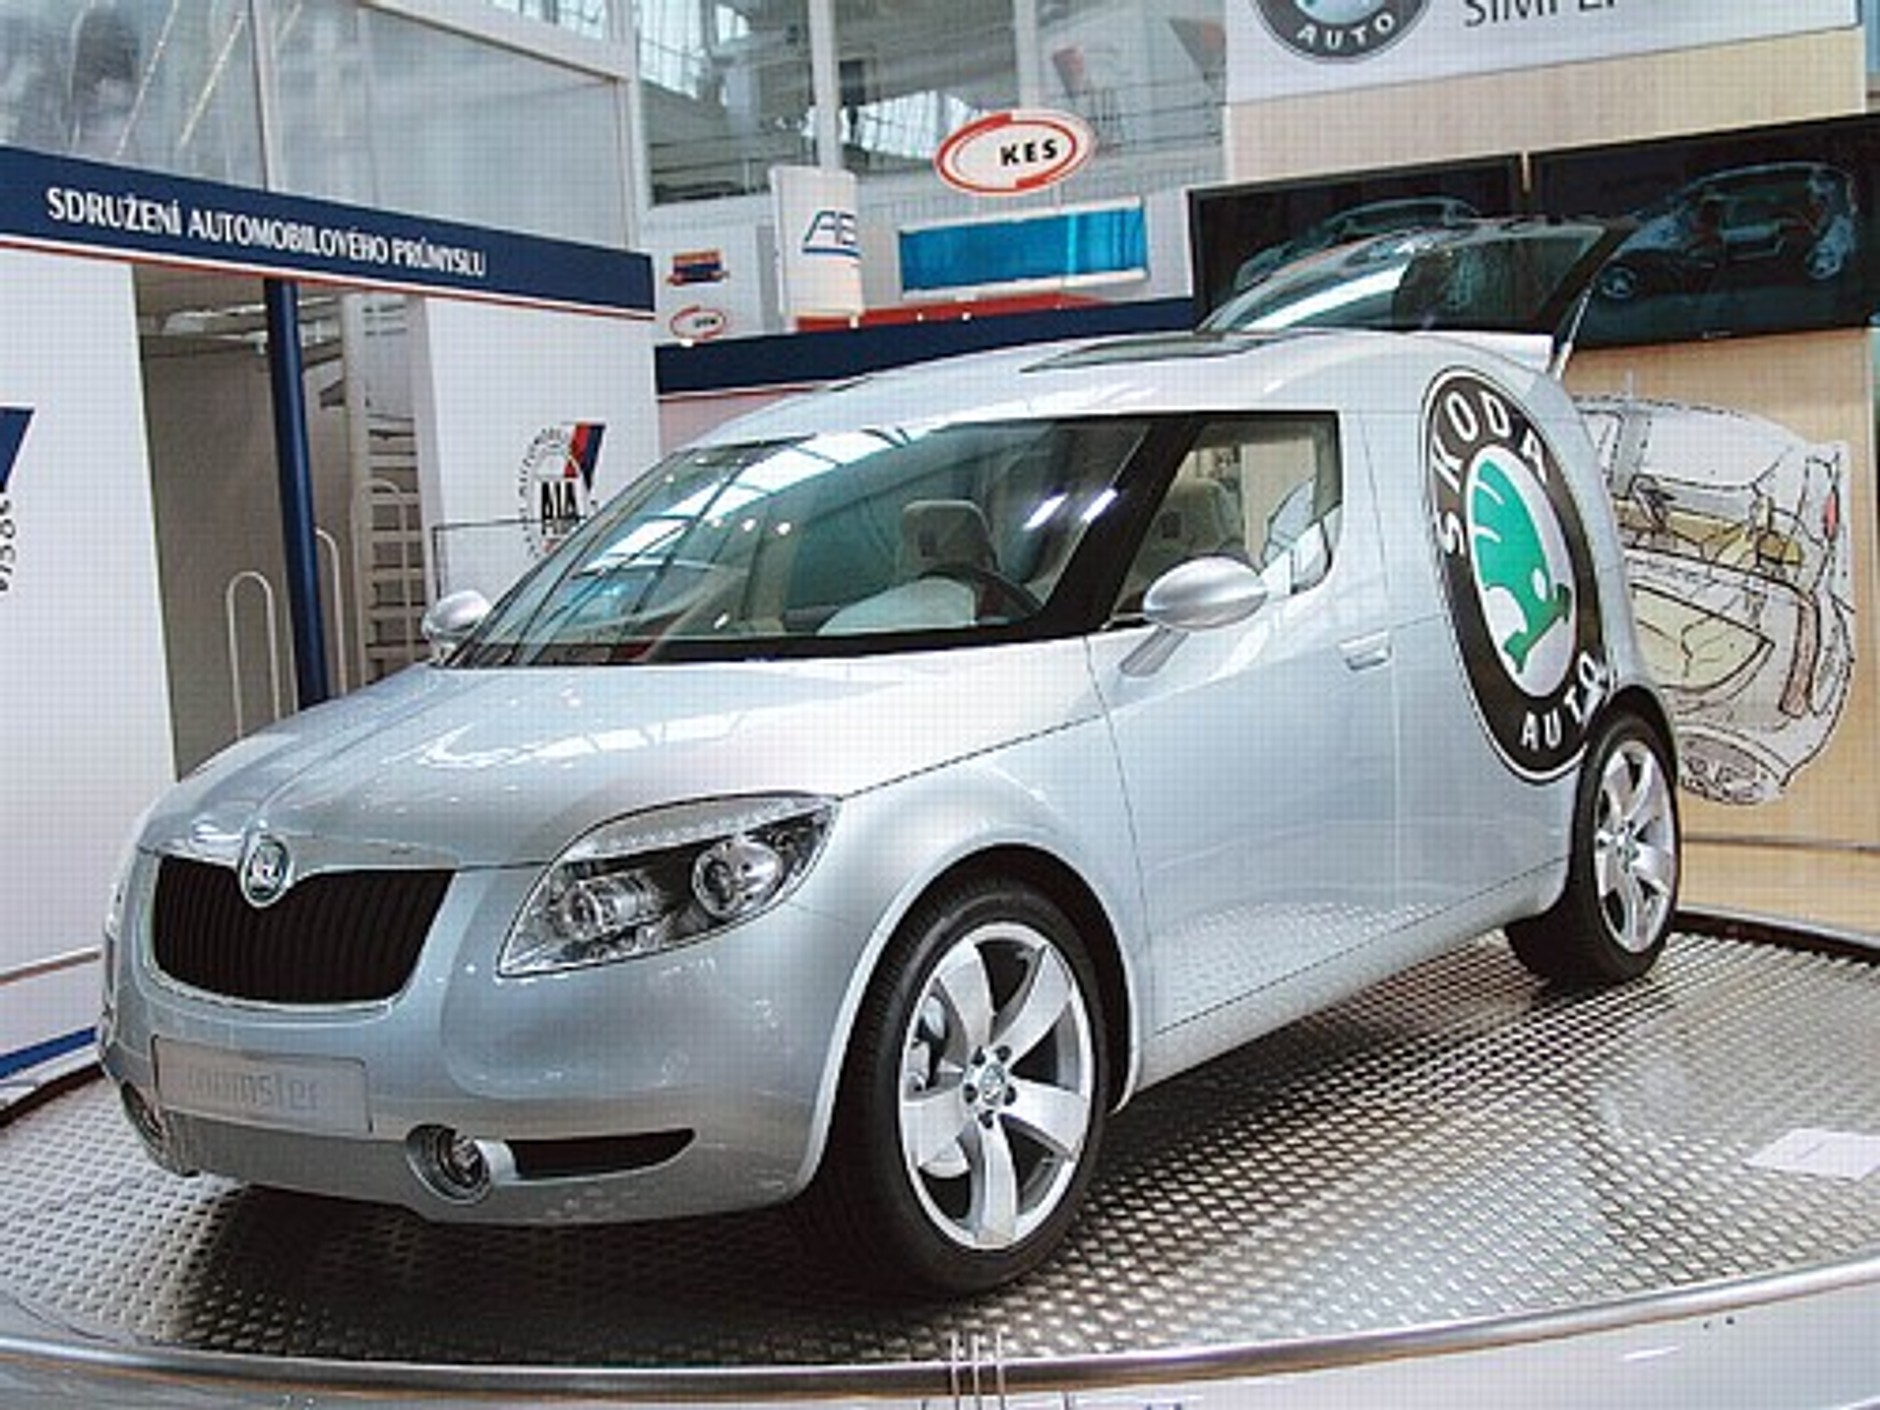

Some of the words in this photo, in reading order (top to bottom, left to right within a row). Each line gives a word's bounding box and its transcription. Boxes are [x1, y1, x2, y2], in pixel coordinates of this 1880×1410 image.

[1298, 13, 1395, 49] AUTO
[1000, 138, 1058, 167] KES
[46, 186, 182, 236] SDRUŽENÍ
[187, 208, 389, 265] AUTOMOBILOVÉHO
[1432, 390, 1549, 556] SKODA
[1520, 652, 1603, 752] AUTO
